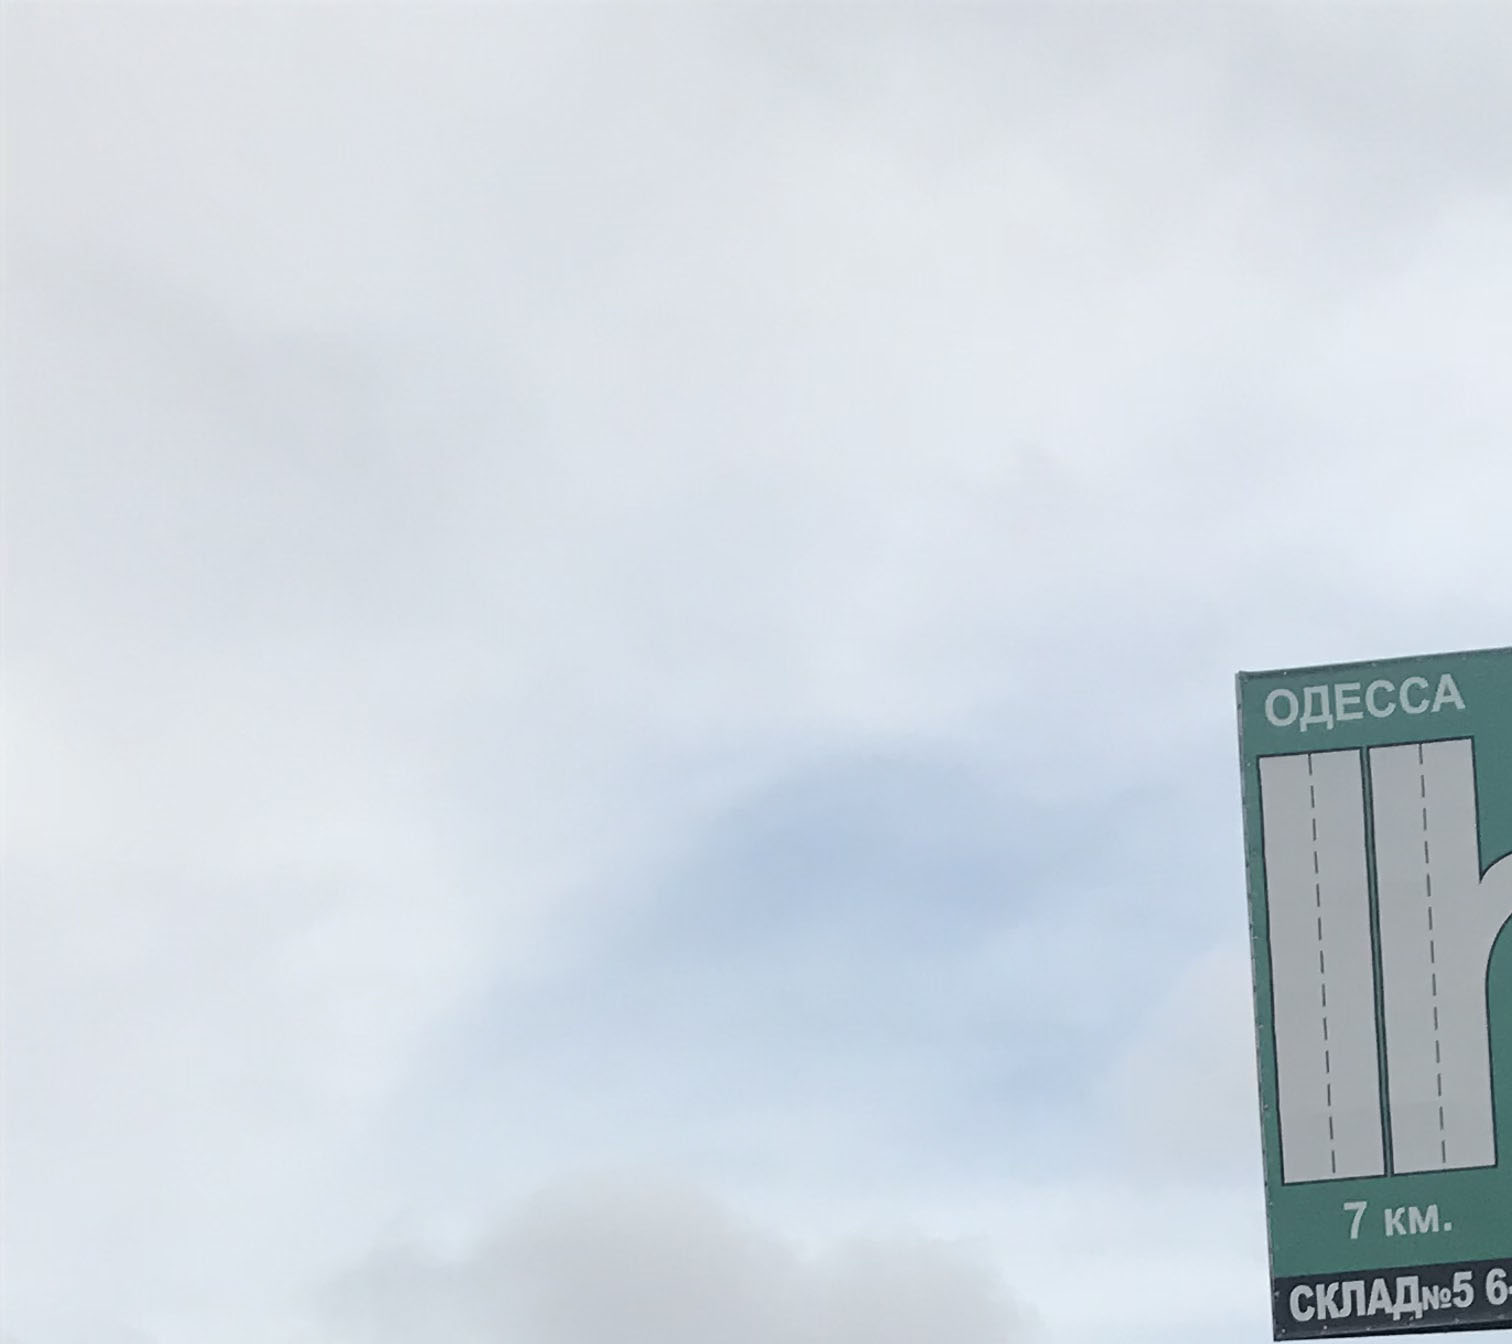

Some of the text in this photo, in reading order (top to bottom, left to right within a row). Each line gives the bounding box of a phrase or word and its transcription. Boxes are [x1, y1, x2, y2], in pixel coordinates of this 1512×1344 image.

[1264, 673, 1466, 732] ОДЕССА
[1343, 1201, 1452, 1240] 7 км.
